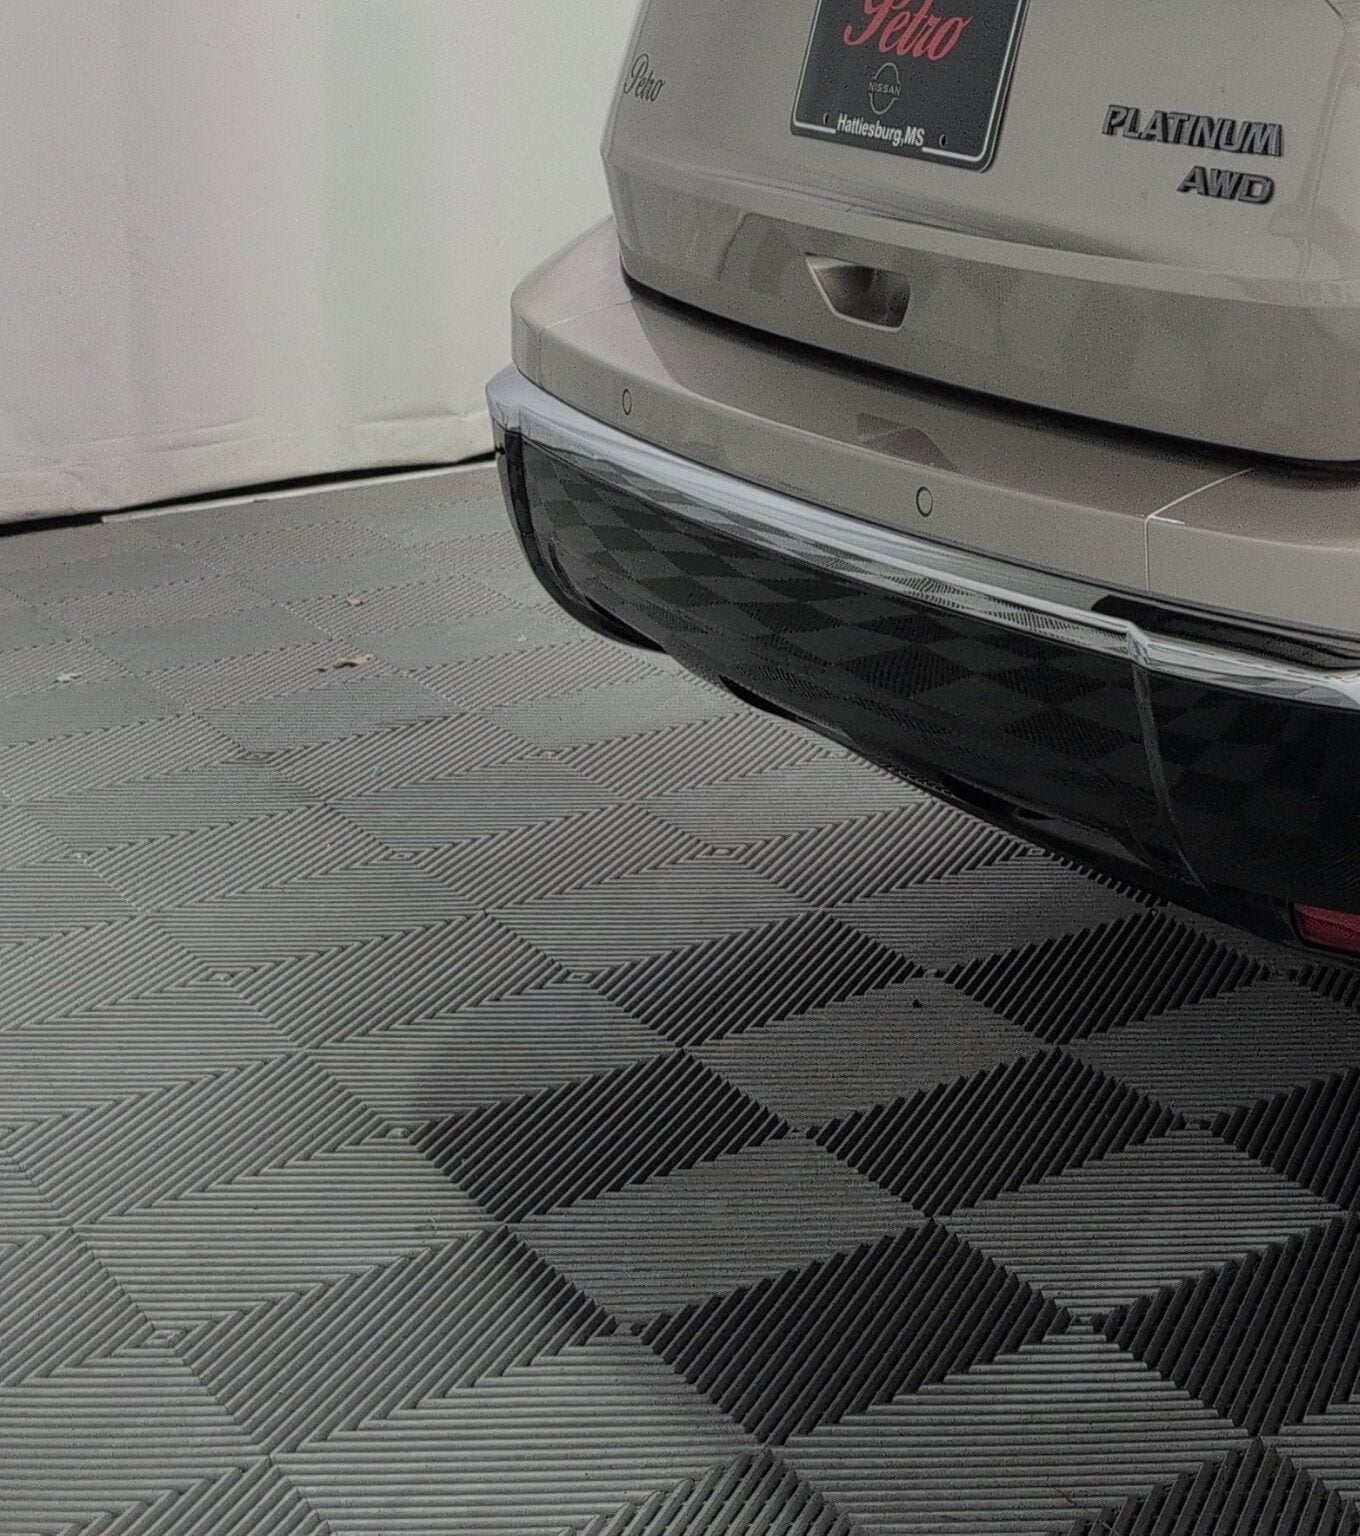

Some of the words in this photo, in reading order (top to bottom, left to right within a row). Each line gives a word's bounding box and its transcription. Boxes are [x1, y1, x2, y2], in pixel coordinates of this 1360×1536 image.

[868, 81, 902, 96] NISSAN
[1102, 104, 1285, 157] PLATINUM
[1177, 166, 1275, 205] AWD
